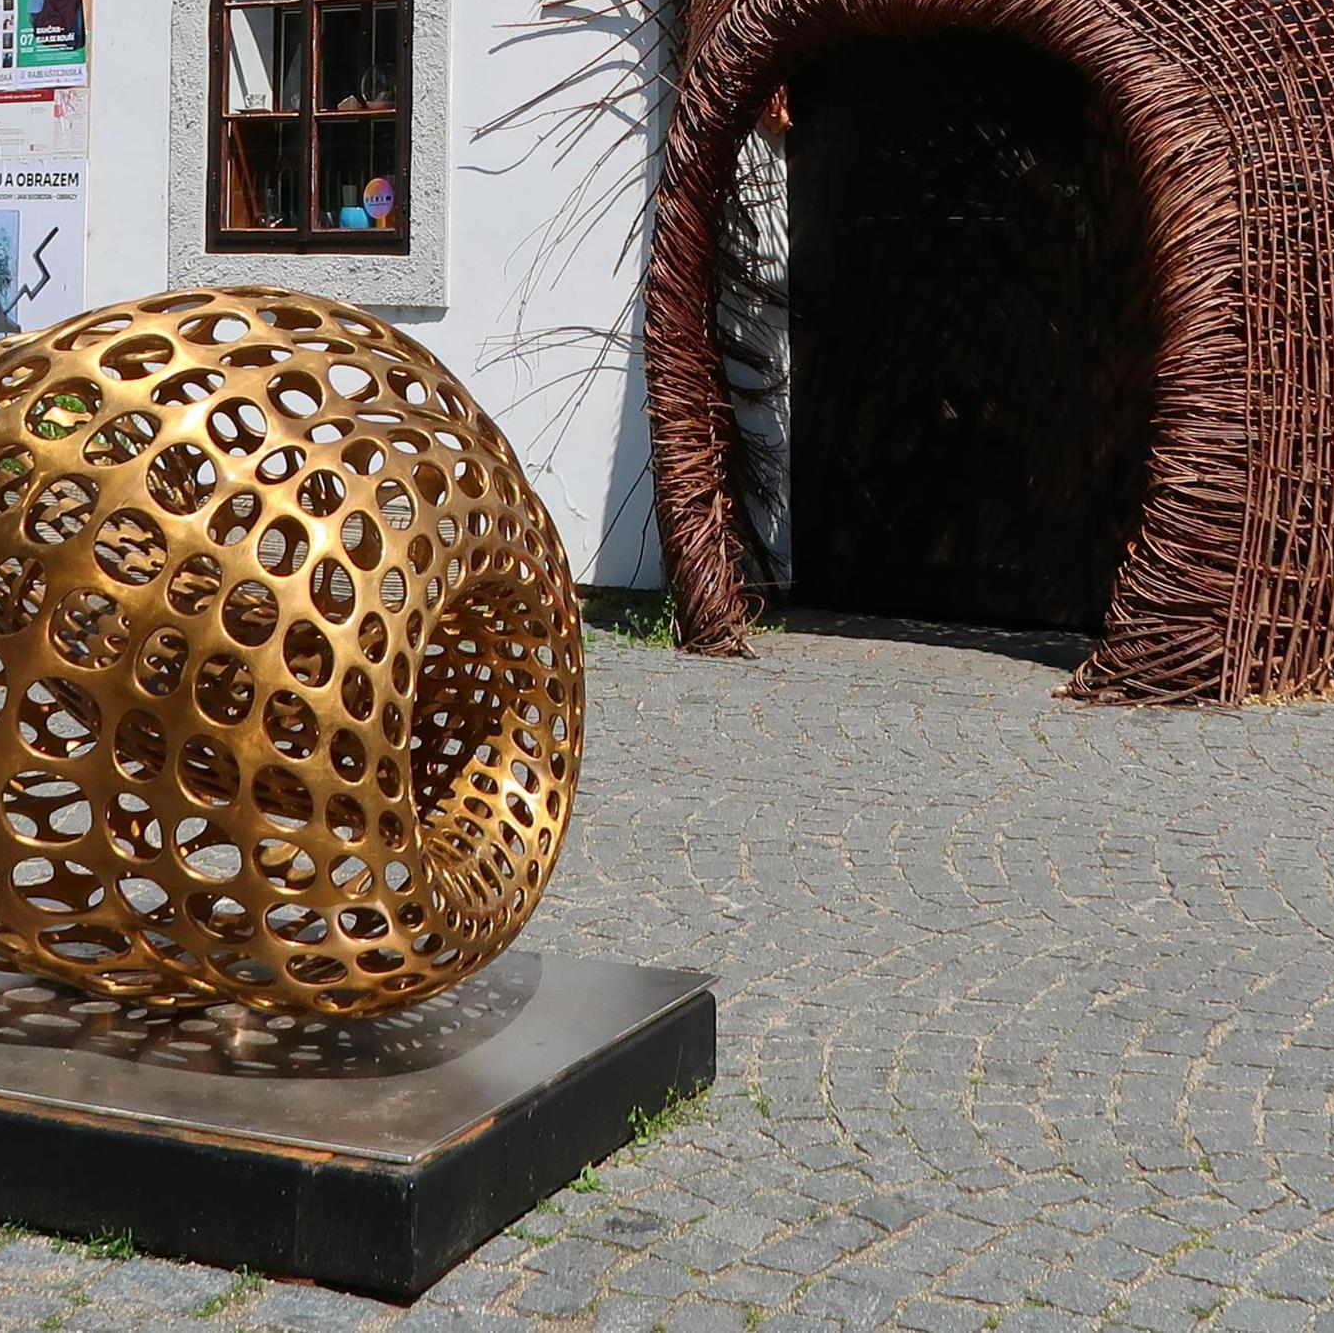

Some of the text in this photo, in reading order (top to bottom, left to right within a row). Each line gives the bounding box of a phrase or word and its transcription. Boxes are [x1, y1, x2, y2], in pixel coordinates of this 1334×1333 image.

[20, 33, 34, 46] 07
[4, 172, 14, 187] A
[16, 172, 80, 187] OBRAZEM
